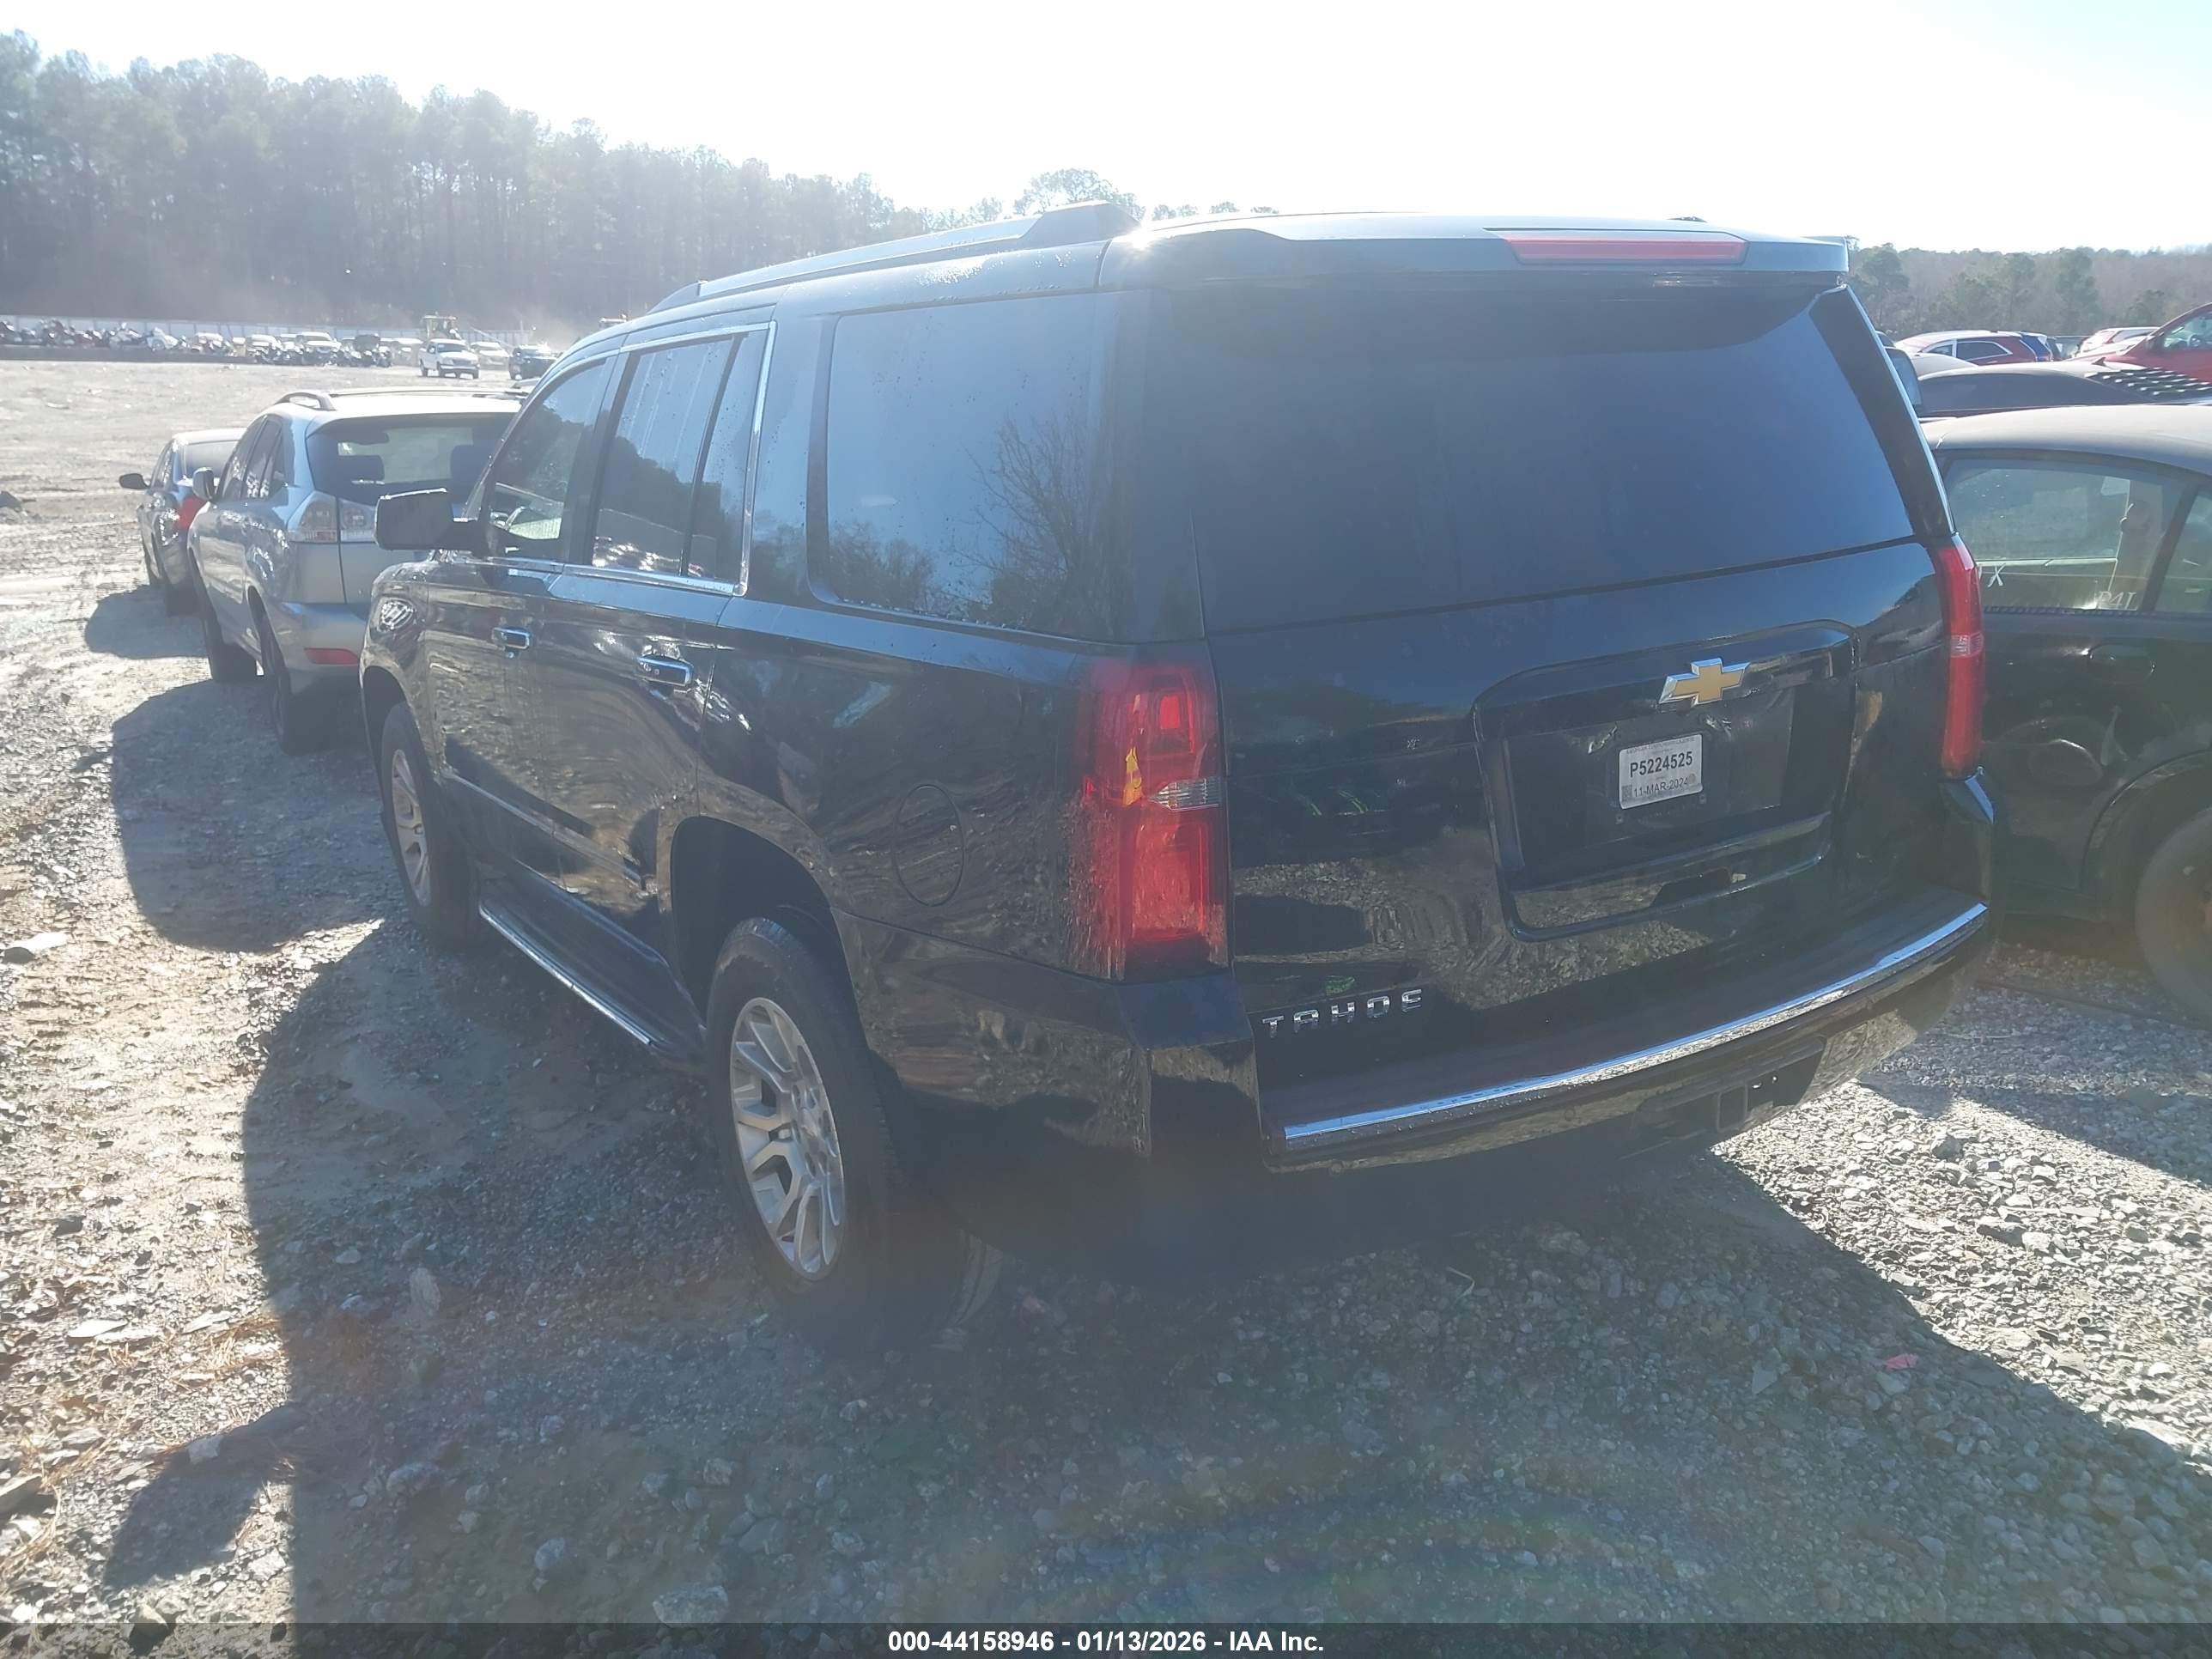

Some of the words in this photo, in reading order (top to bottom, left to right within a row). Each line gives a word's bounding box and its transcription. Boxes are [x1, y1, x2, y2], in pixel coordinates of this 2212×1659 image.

[1630, 750, 1693, 778] P5224525
[1634, 777, 1689, 798] 11-MAR-2024
[1262, 988, 1423, 1038] TAHOE
